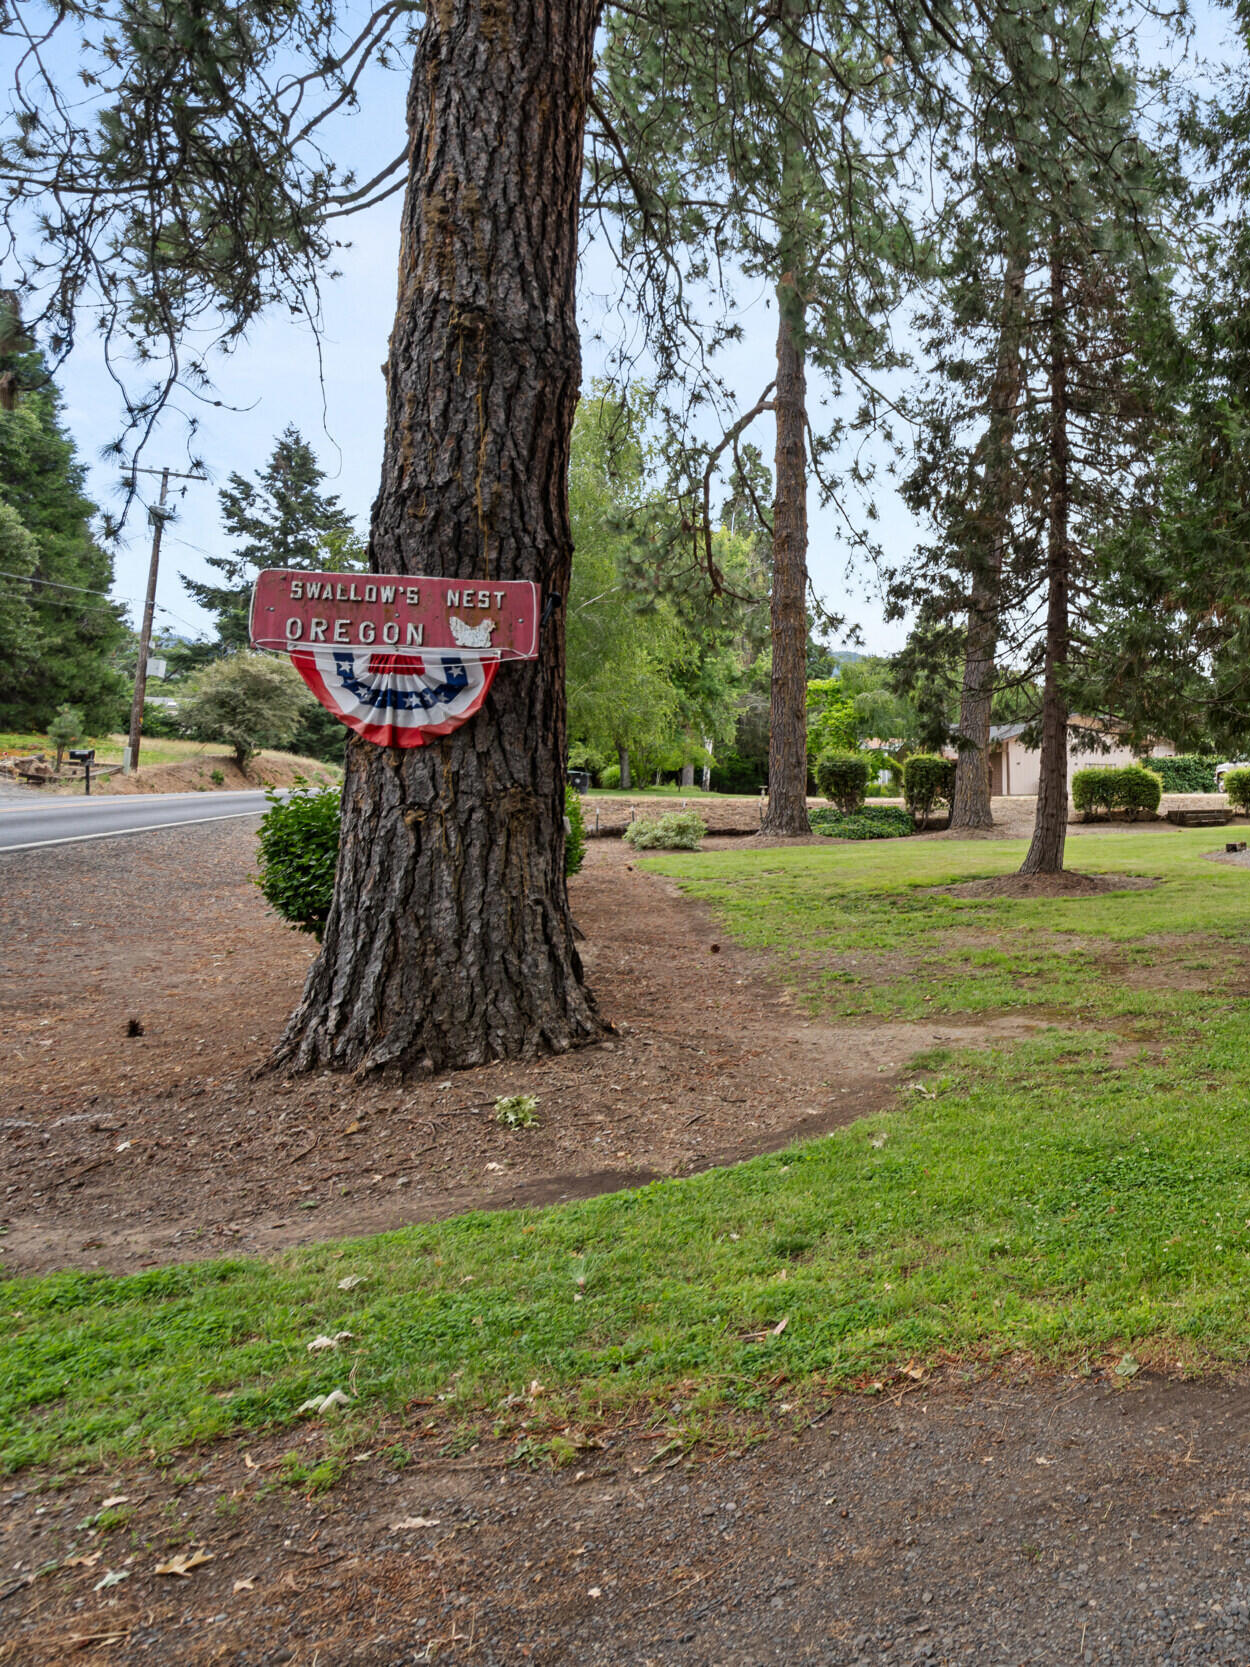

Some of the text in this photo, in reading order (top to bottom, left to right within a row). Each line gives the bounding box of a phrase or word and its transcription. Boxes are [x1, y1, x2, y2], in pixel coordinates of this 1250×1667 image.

[290, 581, 505, 609] SWALLOW'S NEST
[285, 617, 424, 646] OREGON
